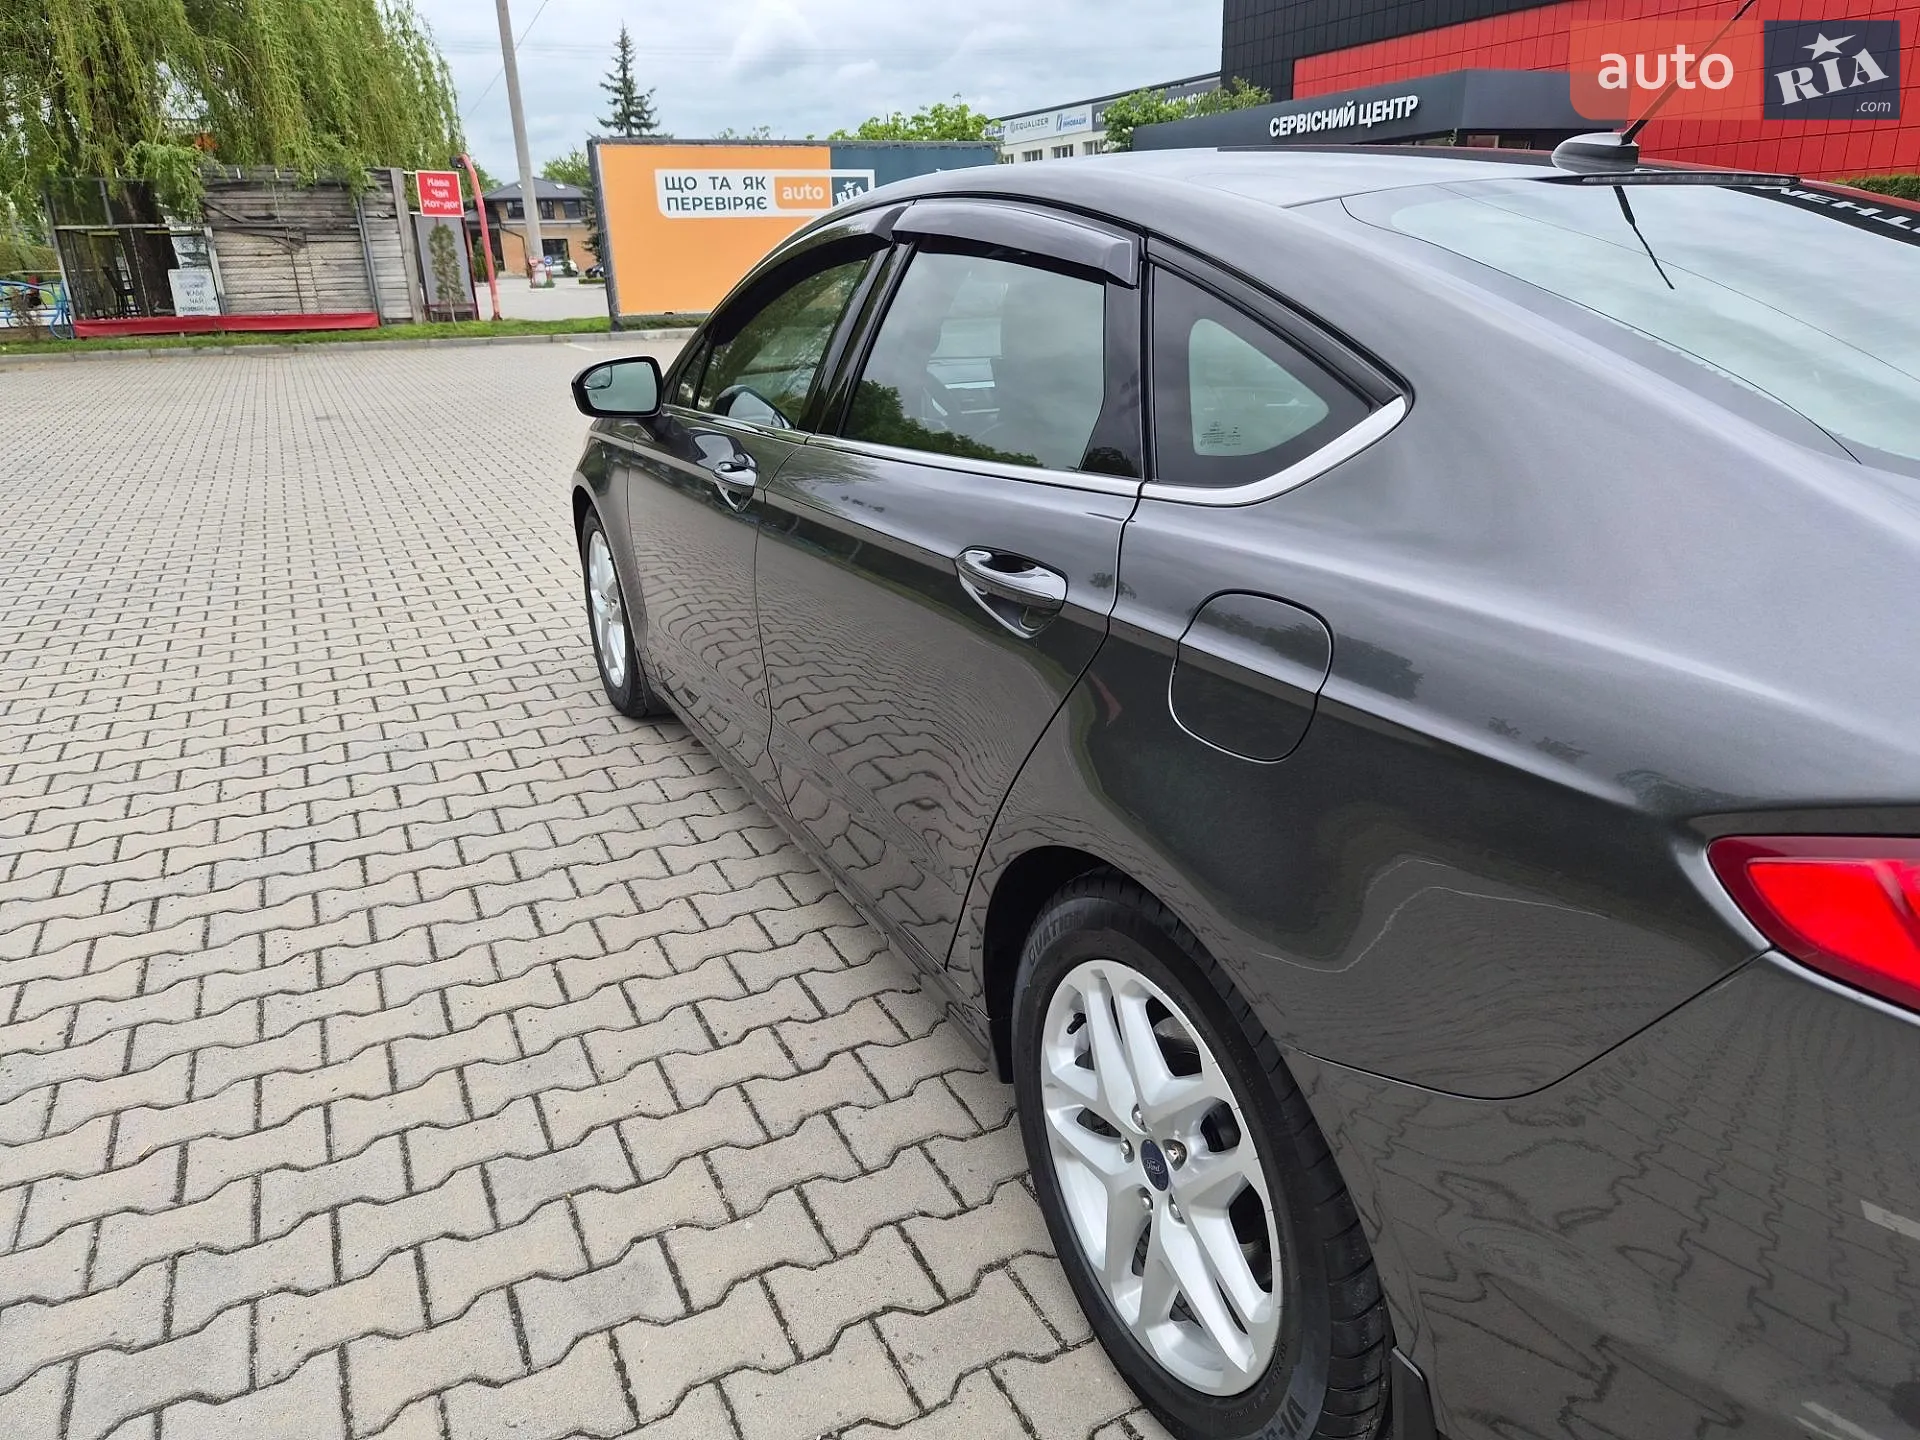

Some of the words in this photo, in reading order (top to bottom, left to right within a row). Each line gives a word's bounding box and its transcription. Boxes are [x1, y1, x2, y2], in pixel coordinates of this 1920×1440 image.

[1015, 117, 1049, 130] EQUALIZER
[1269, 100, 1356, 137] СЕРВІСНИЙ
[1358, 94, 1418, 128] ЦЕНТР
[664, 176, 698, 193] ЩО
[708, 176, 731, 190] ТА
[743, 176, 767, 190] ЯК
[782, 183, 825, 201] auto
[667, 196, 768, 212] ПЕРЕВІРЯЄ
